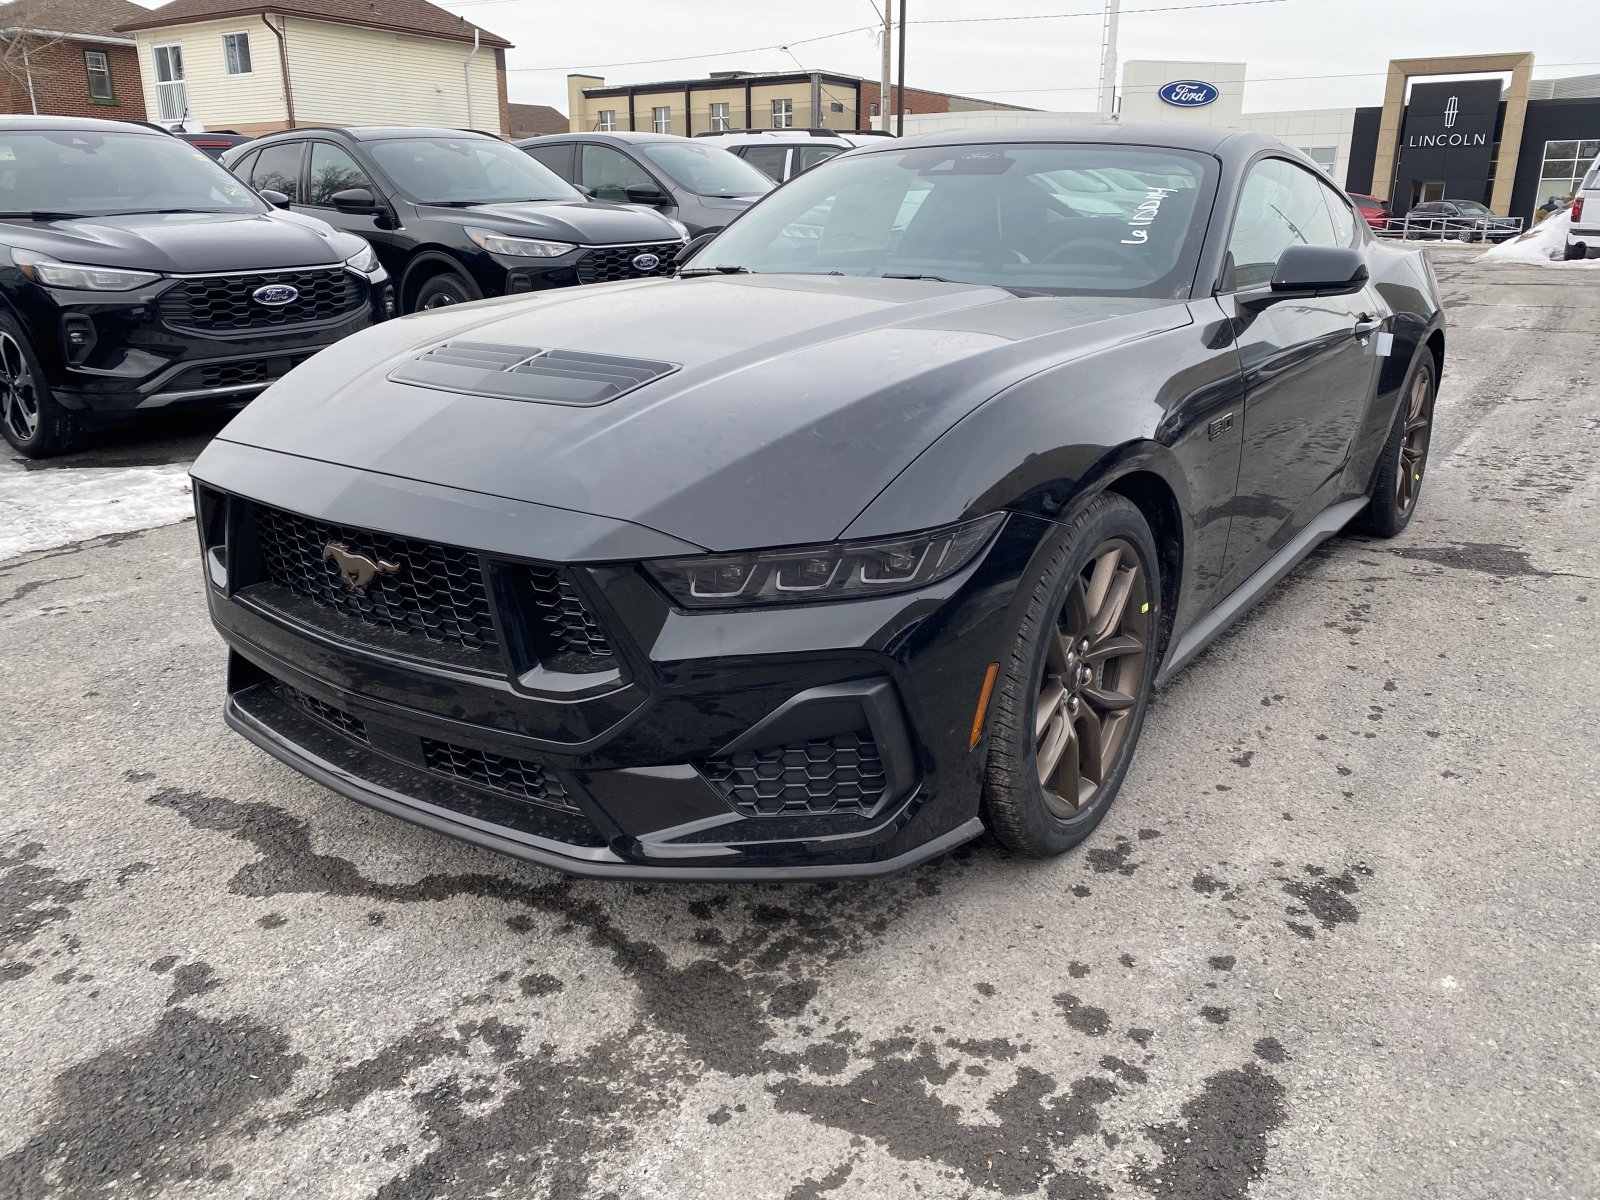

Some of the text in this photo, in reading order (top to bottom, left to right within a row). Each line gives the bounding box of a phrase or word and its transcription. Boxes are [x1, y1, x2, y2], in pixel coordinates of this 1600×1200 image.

[1172, 84, 1207, 101] Ford
[1409, 133, 1486, 147] LINCOLN
[265, 289, 289, 301] Ford
